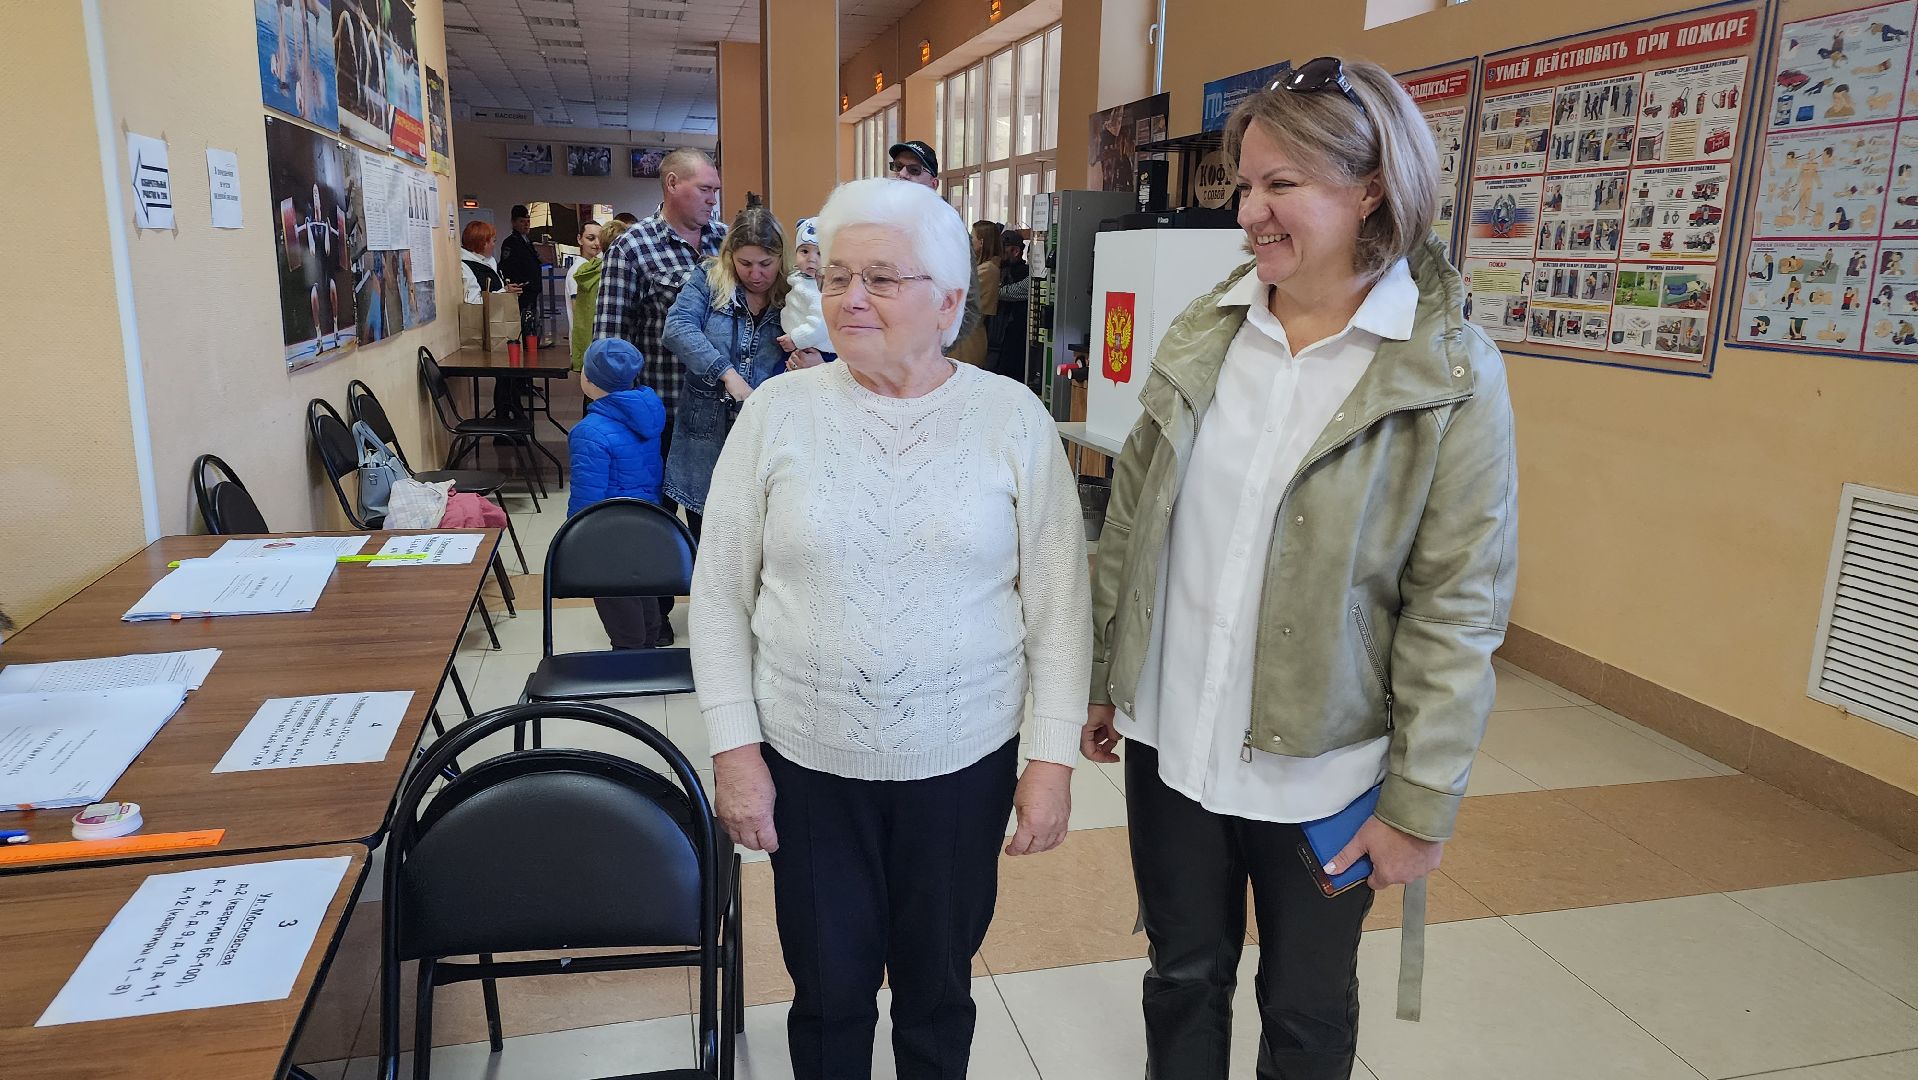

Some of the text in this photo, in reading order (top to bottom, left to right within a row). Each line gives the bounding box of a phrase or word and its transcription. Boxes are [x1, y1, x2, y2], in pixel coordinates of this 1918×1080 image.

[1496, 16, 1749, 81] УМЕЙ ДЕЙСТВОВАТЬ ПРИ ПОЖАРЕ
[140, 909, 184, 955] (квартиры
[175, 931, 196, 939] 9,
[205, 898, 244, 944] (квартиры
[220, 893, 273, 965] Ул. Московская
[157, 954, 180, 968] 10,
[174, 948, 214, 987] 66-100),
[110, 984, 132, 995] 8)
[138, 985, 161, 1001] 11,
